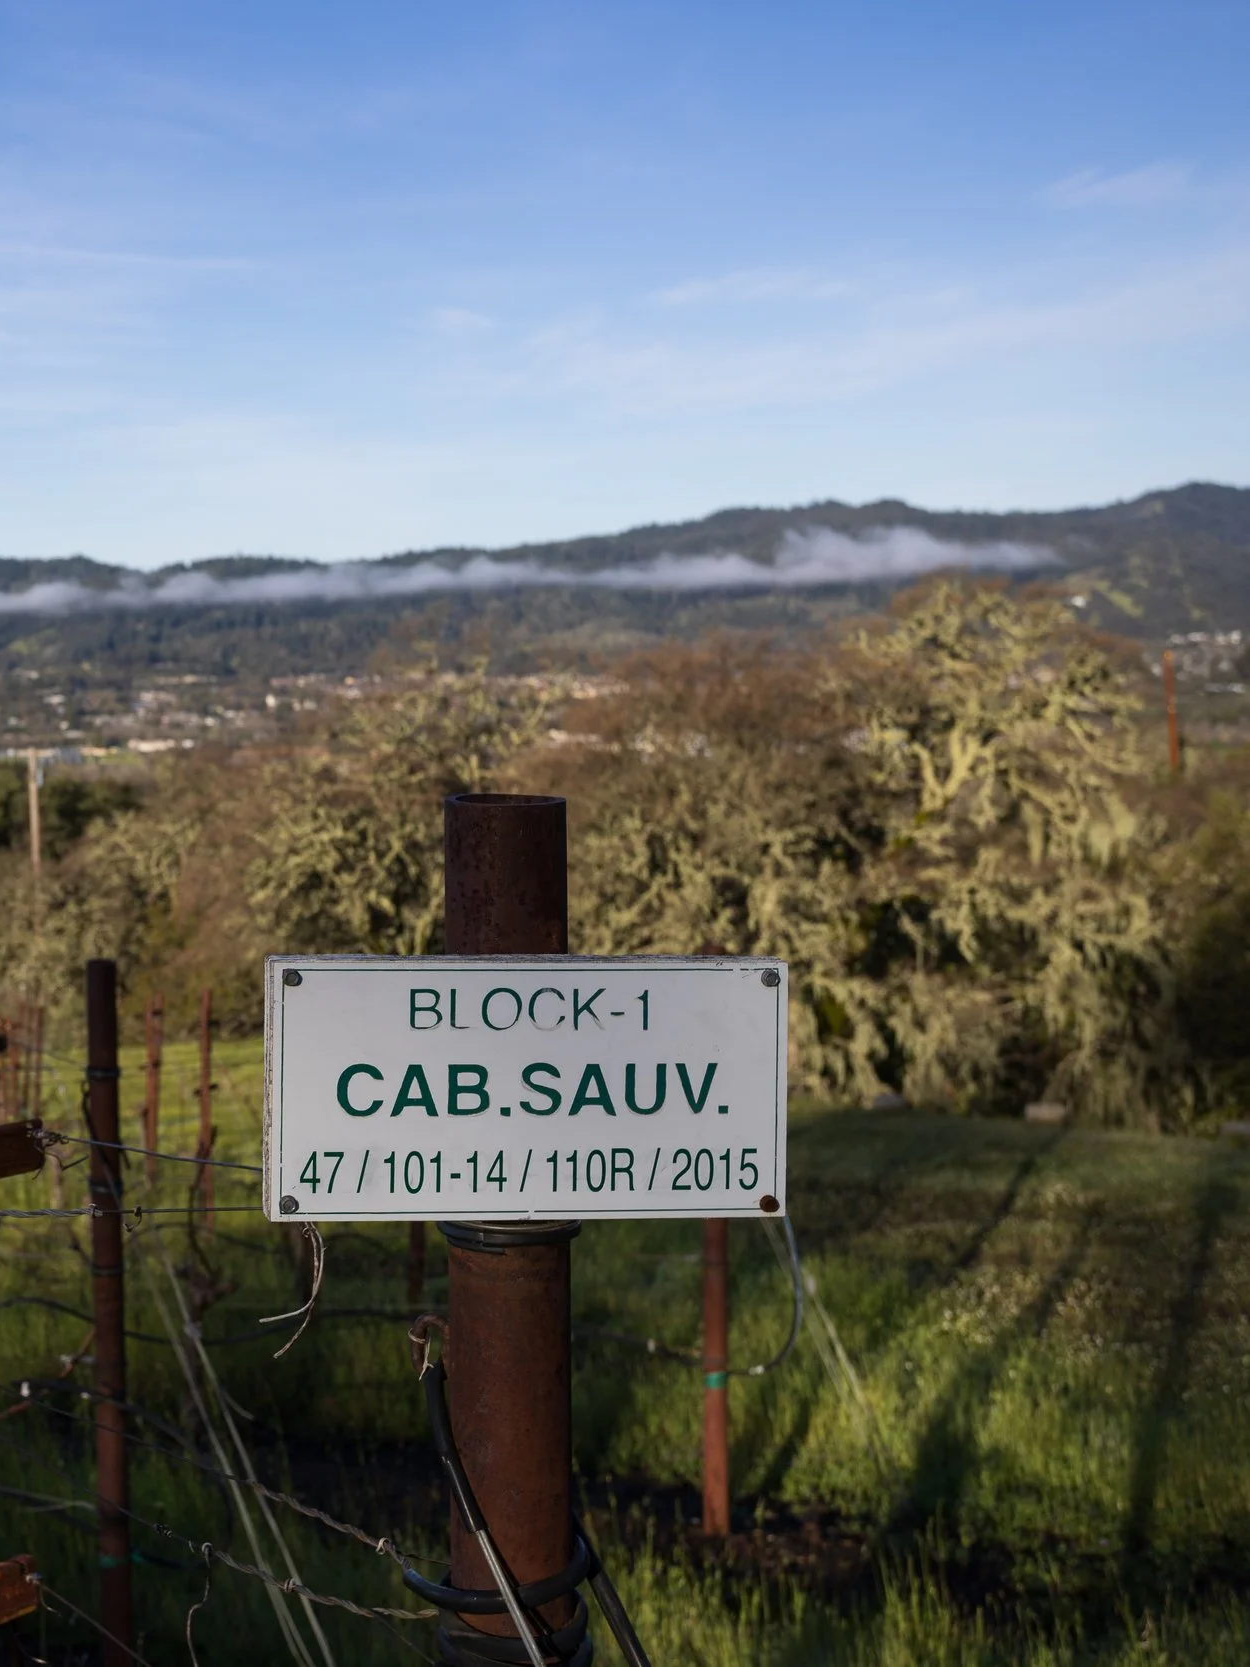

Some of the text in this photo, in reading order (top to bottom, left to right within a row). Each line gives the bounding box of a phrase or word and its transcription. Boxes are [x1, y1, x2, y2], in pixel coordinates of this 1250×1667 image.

[408, 986, 650, 1032] BLOCK-1
[299, 1147, 760, 1195] 47 / 101-14 / 110R / 2015
